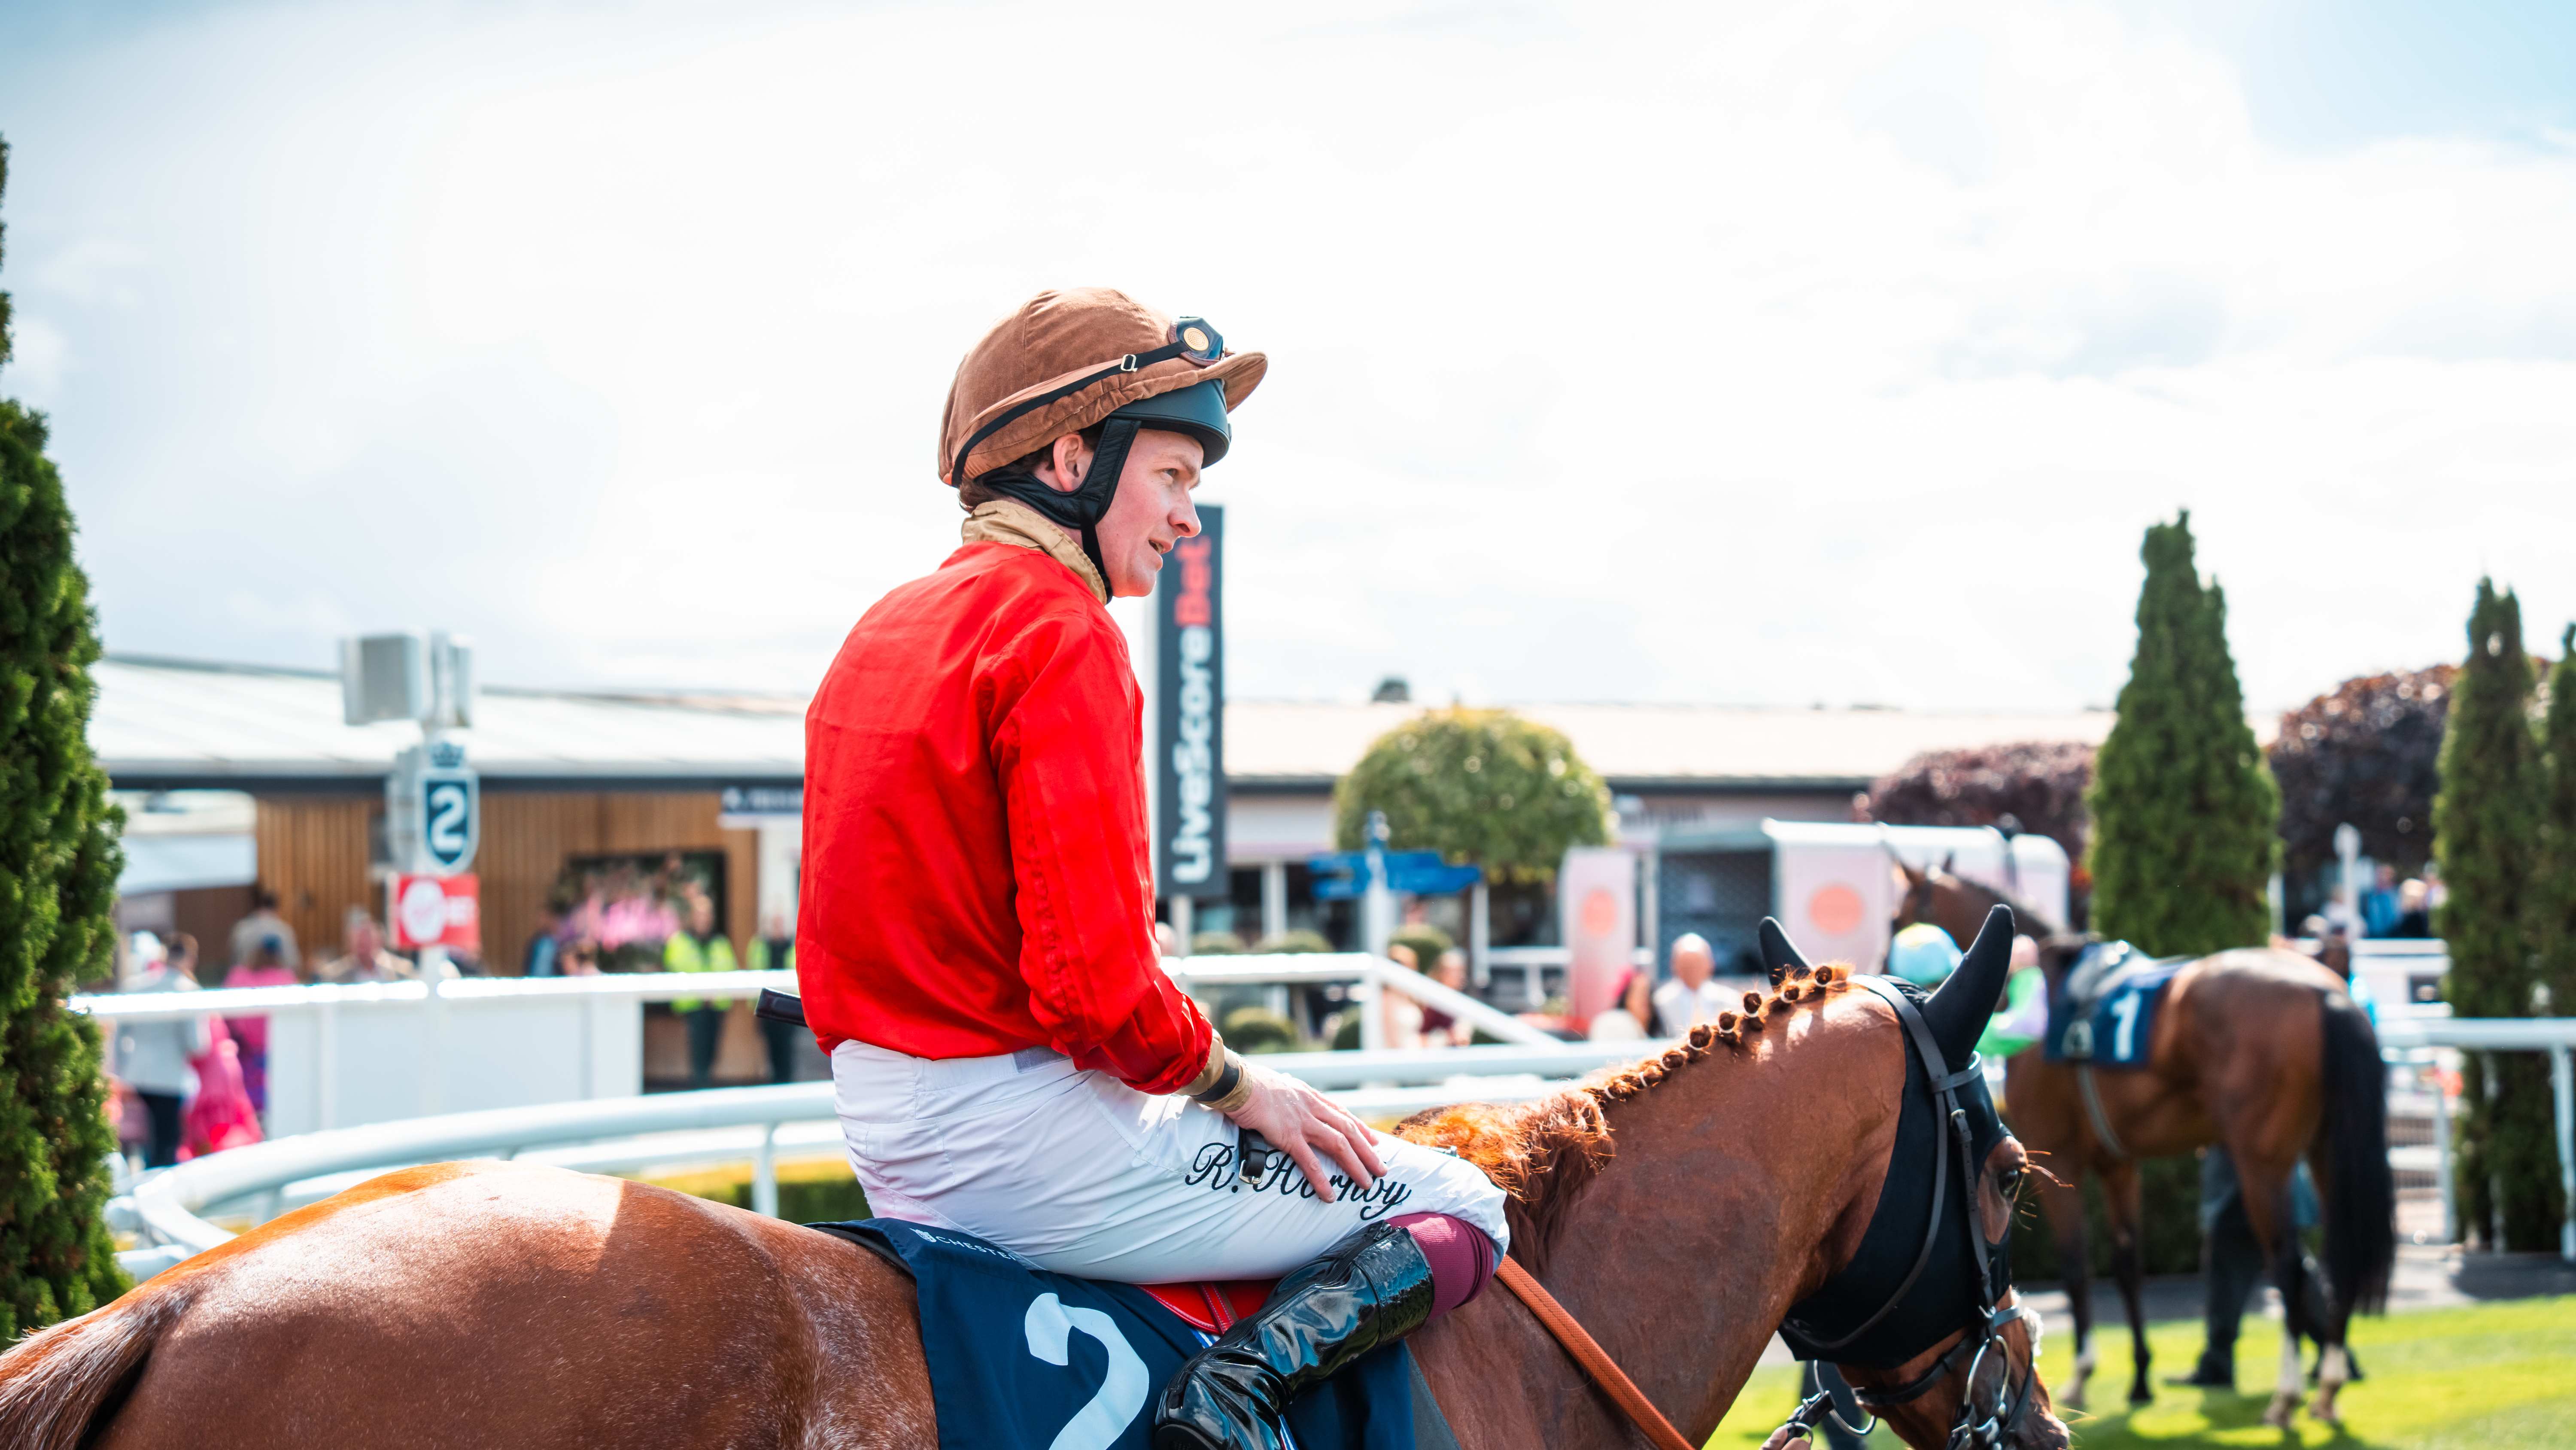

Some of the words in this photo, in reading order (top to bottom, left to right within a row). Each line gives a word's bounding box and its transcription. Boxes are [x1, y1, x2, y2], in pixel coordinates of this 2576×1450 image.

[431, 785, 465, 851] 2
[2111, 989, 2141, 1061] 1
[1185, 1143, 1238, 1193] R.
[1025, 1292, 1149, 1450] 2
